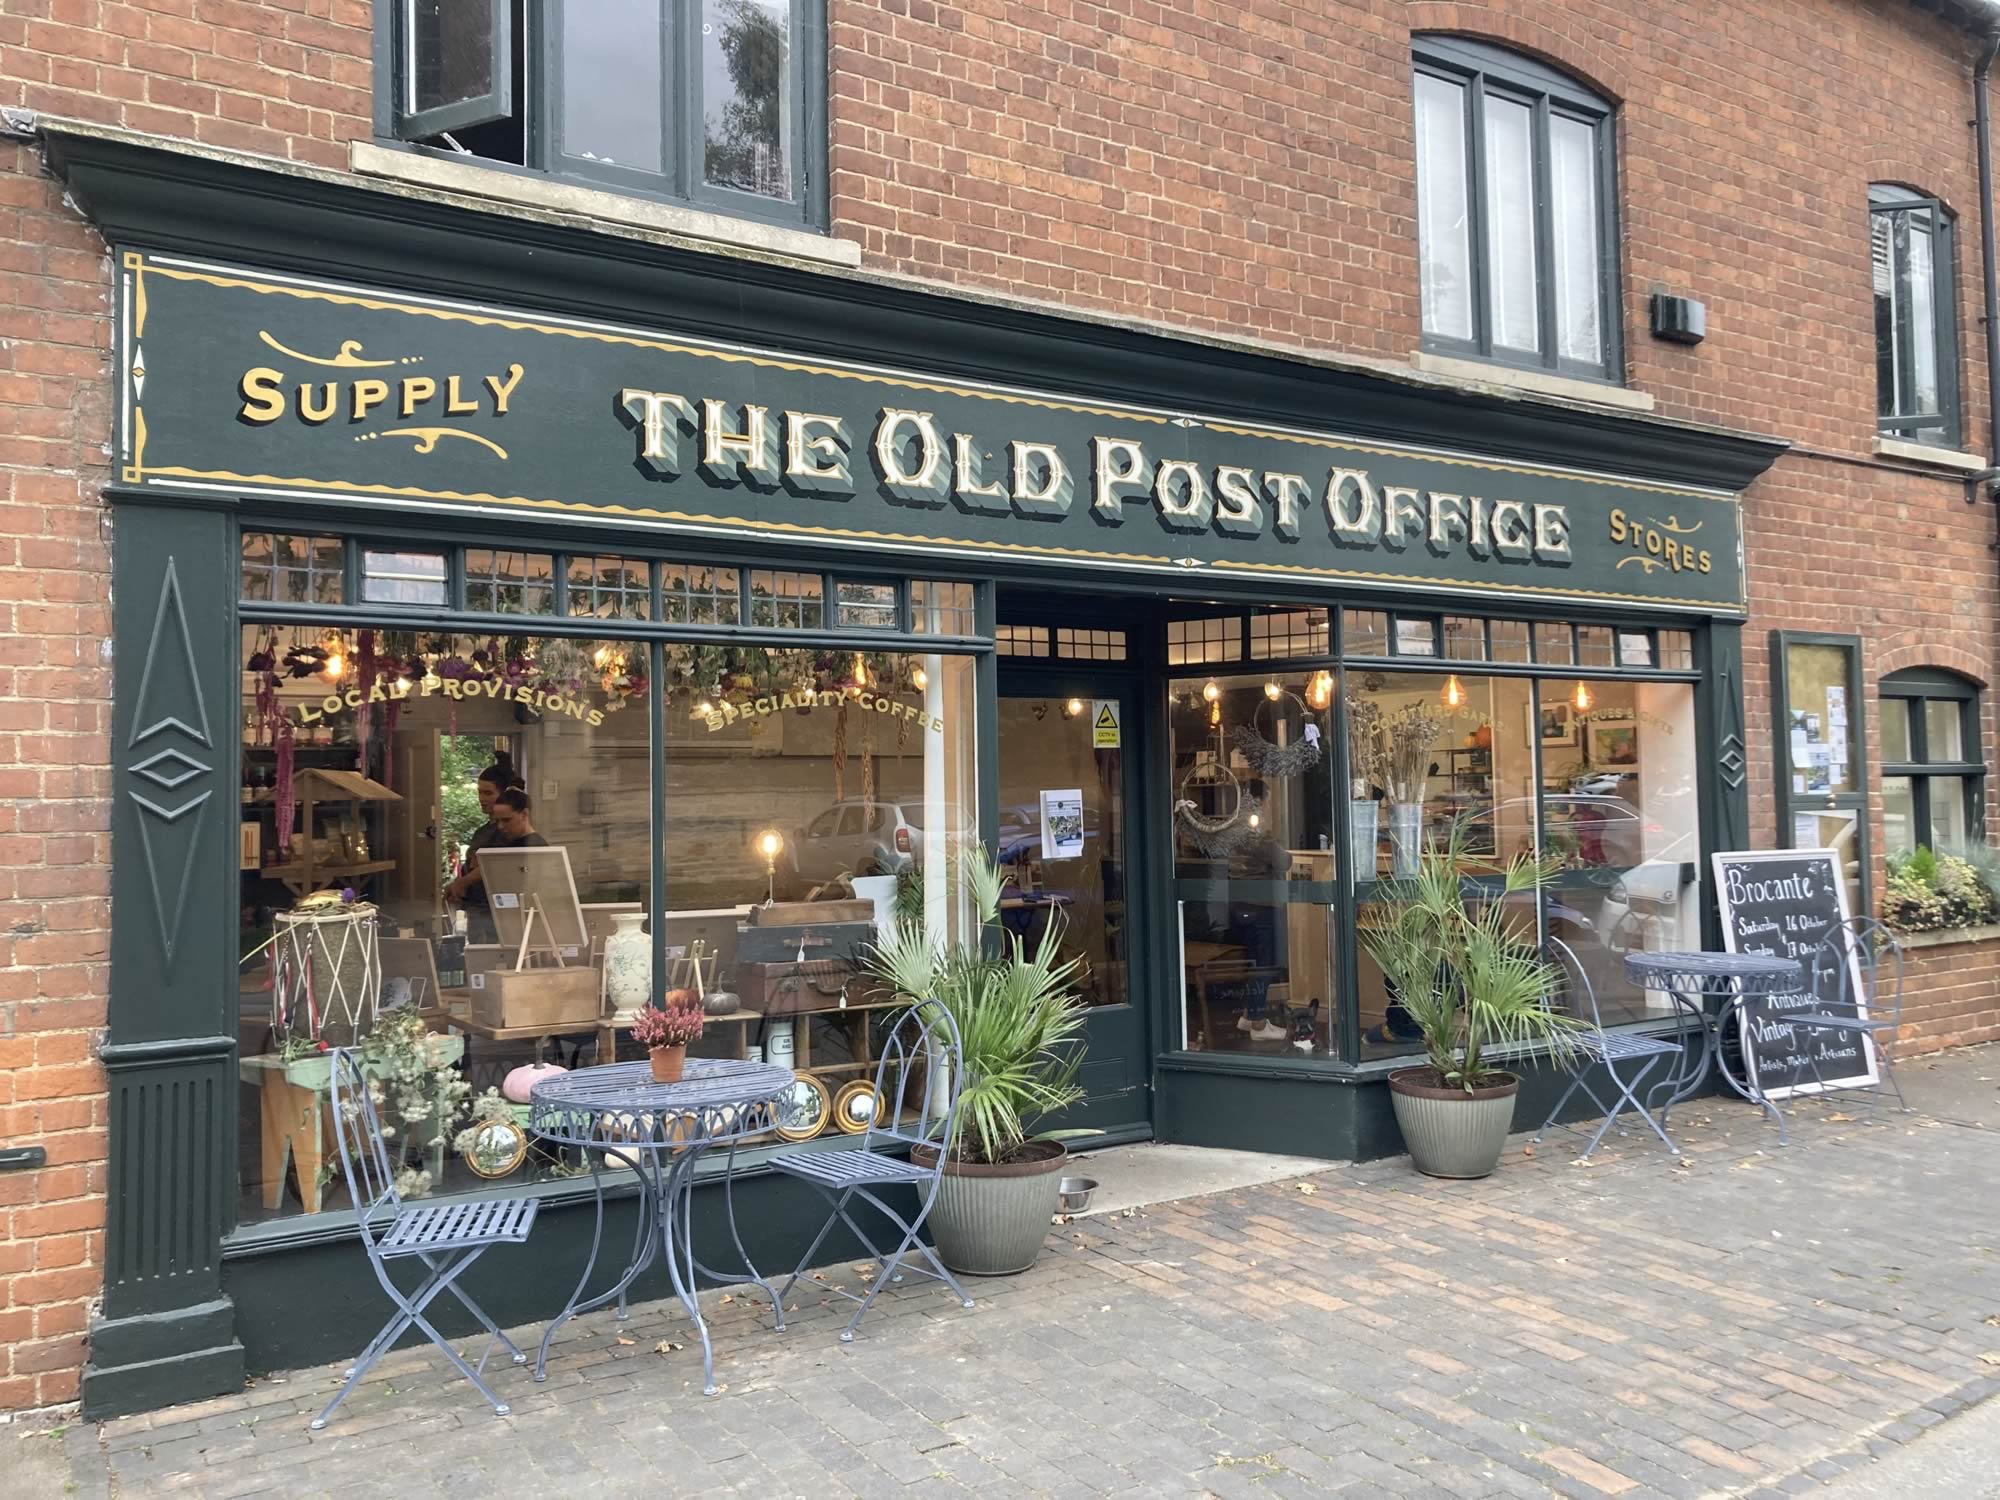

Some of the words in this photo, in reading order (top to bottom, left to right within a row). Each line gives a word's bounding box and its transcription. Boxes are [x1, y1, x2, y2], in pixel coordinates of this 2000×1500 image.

[238, 363, 524, 425] SUPPLY
[616, 388, 852, 496] THE
[871, 407, 1071, 516] OLD
[1091, 436, 1309, 540] POST
[1328, 466, 1570, 562] OFFICE
[1609, 508, 1711, 573] STORES
[297, 681, 412, 724] LOCAL
[420, 675, 605, 728] PROVISIONS
[704, 687, 849, 732] SPECIALITY
[858, 692, 945, 733] COFFEE
[1369, 702, 1454, 736] COURTYARD
[1730, 868, 1814, 905] Brocante
[1738, 916, 1781, 941] Saturday
[1785, 915, 1798, 931] 16
[1799, 914, 1828, 931] October
[1787, 941, 1797, 959] 17
[1750, 1015, 1803, 1051] Vintag
